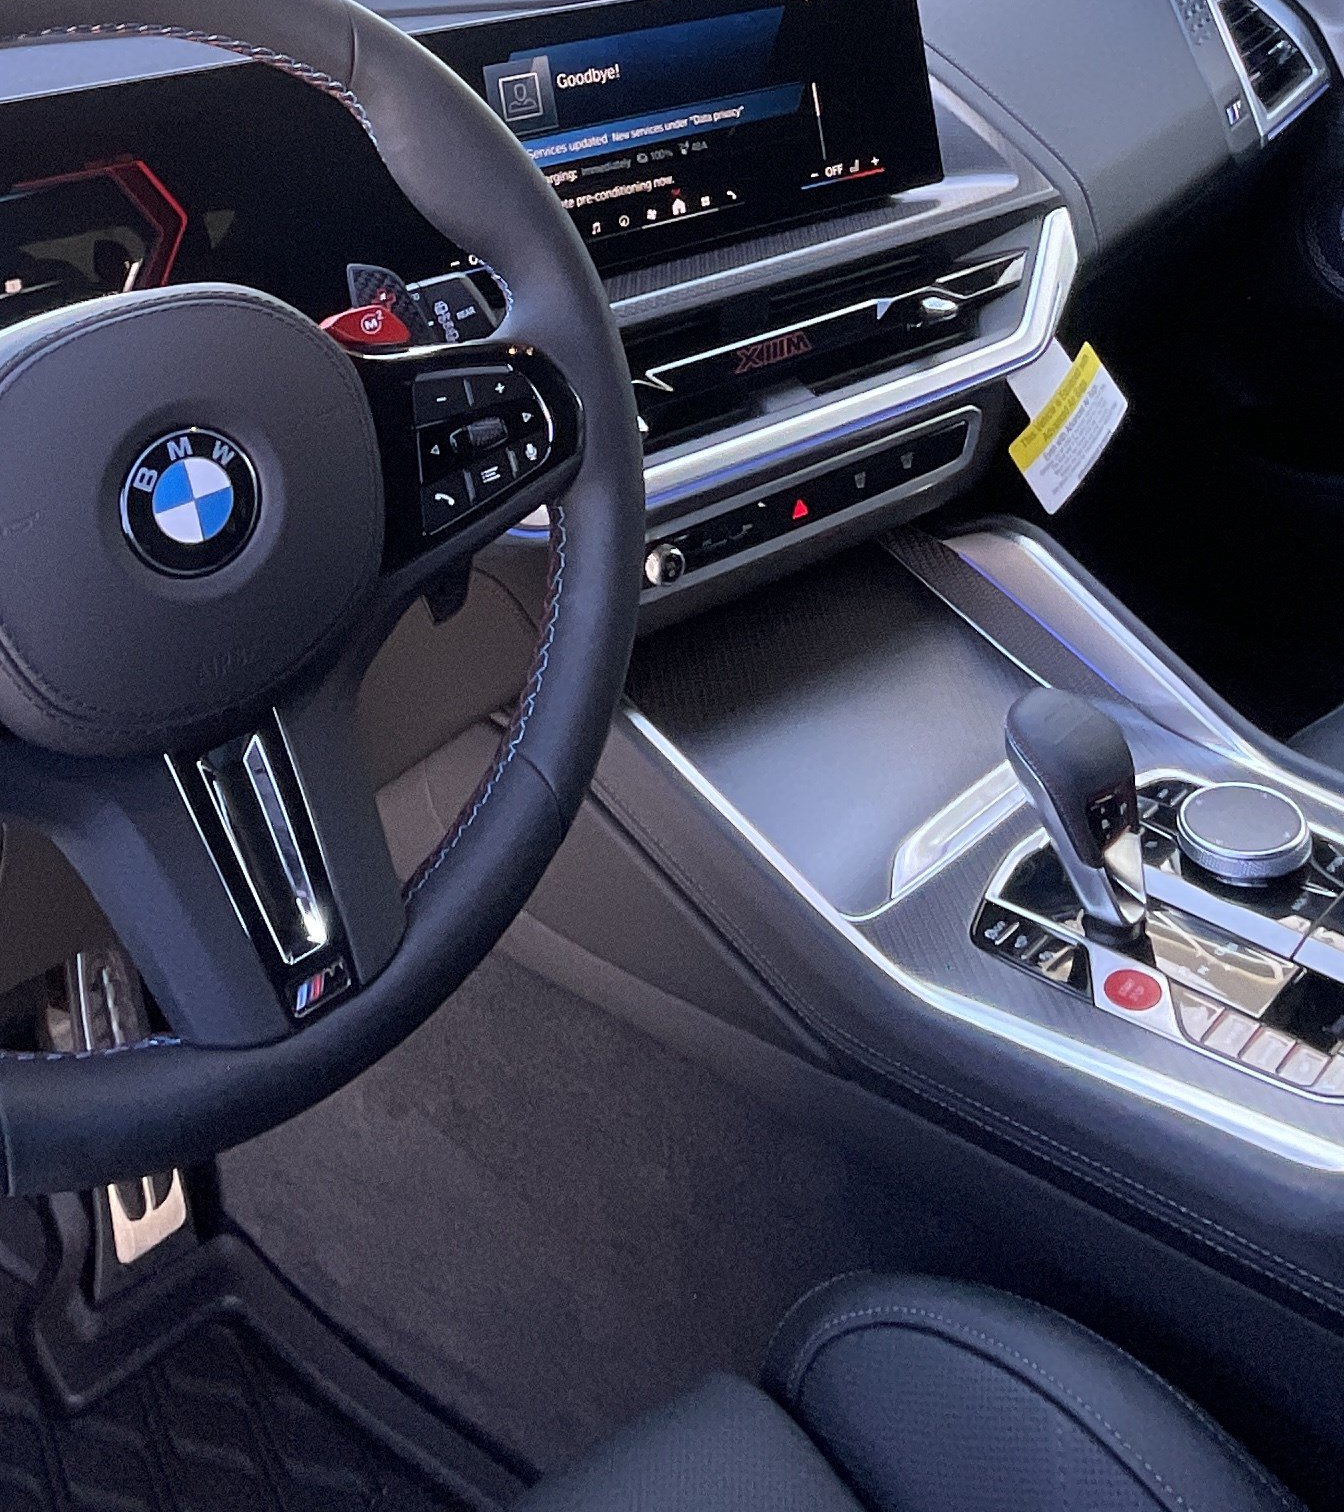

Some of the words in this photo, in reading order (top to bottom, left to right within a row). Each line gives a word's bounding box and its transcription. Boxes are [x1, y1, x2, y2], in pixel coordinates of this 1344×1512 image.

[556, 64, 620, 88] Goodbye!
[527, 144, 567, 159] Services
[569, 134, 608, 152] updated
[612, 130, 630, 142] New
[631, 123, 664, 138] services
[665, 118, 688, 131] under
[824, 162, 844, 178] OFF
[576, 179, 653, 207] pre-conditioning
[133, 436, 236, 493] BMW
